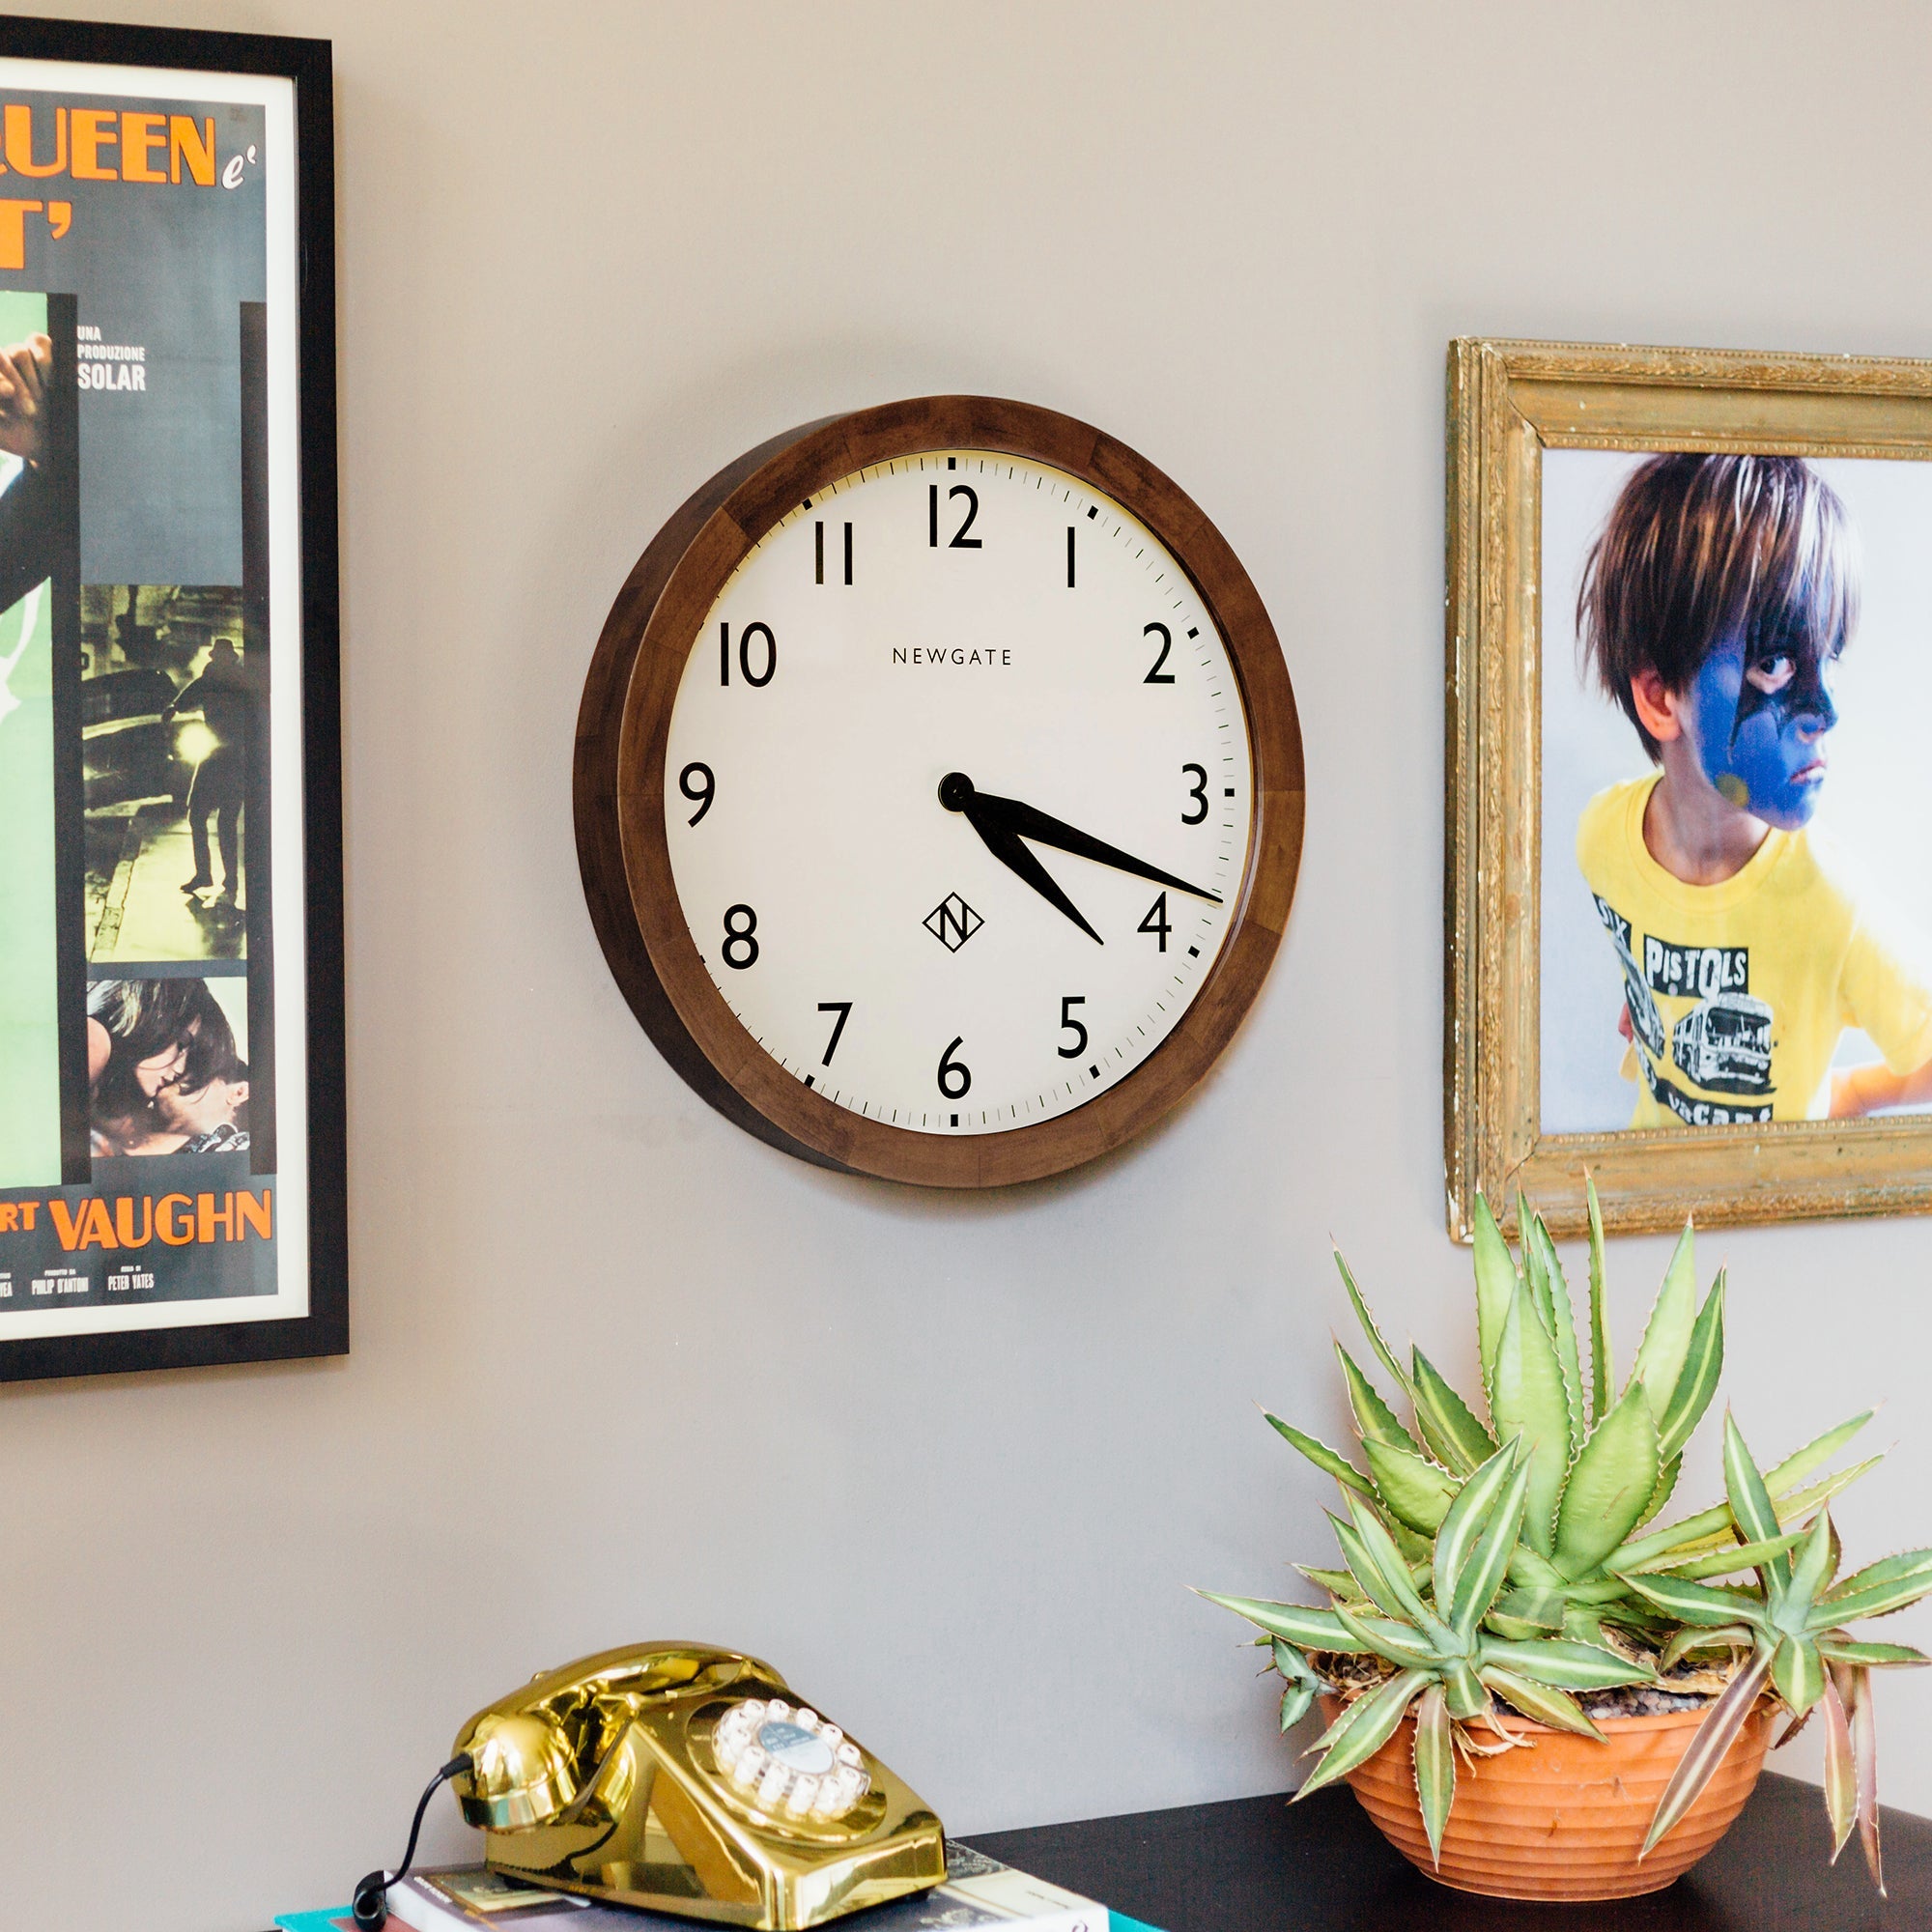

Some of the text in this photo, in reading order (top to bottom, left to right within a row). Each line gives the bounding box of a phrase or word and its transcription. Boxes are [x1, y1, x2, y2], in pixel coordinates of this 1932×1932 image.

[0, 104, 216, 186] UEEN
[77, 326, 101, 342] UNA
[77, 345, 146, 361] PRODUZIONE
[77, 363, 146, 391] SOLAR
[929, 485, 982, 549] 12
[815, 522, 853, 586] 11
[1067, 526, 1075, 588] 1
[720, 622, 777, 688] 10
[893, 647, 1012, 666] NEWGATE
[1144, 622, 1176, 684] 2
[679, 762, 716, 828] 9
[1181, 763, 1209, 826] 3
[722, 904, 759, 970] 8
[1137, 892, 1173, 953] 4
[818, 1003, 854, 1067] 7
[1058, 997, 1089, 1060] 5
[938, 1037, 972, 1100] 6
[48, 1189, 272, 1252] VAUGHN
[108, 1273, 155, 1292] PETER YATES
